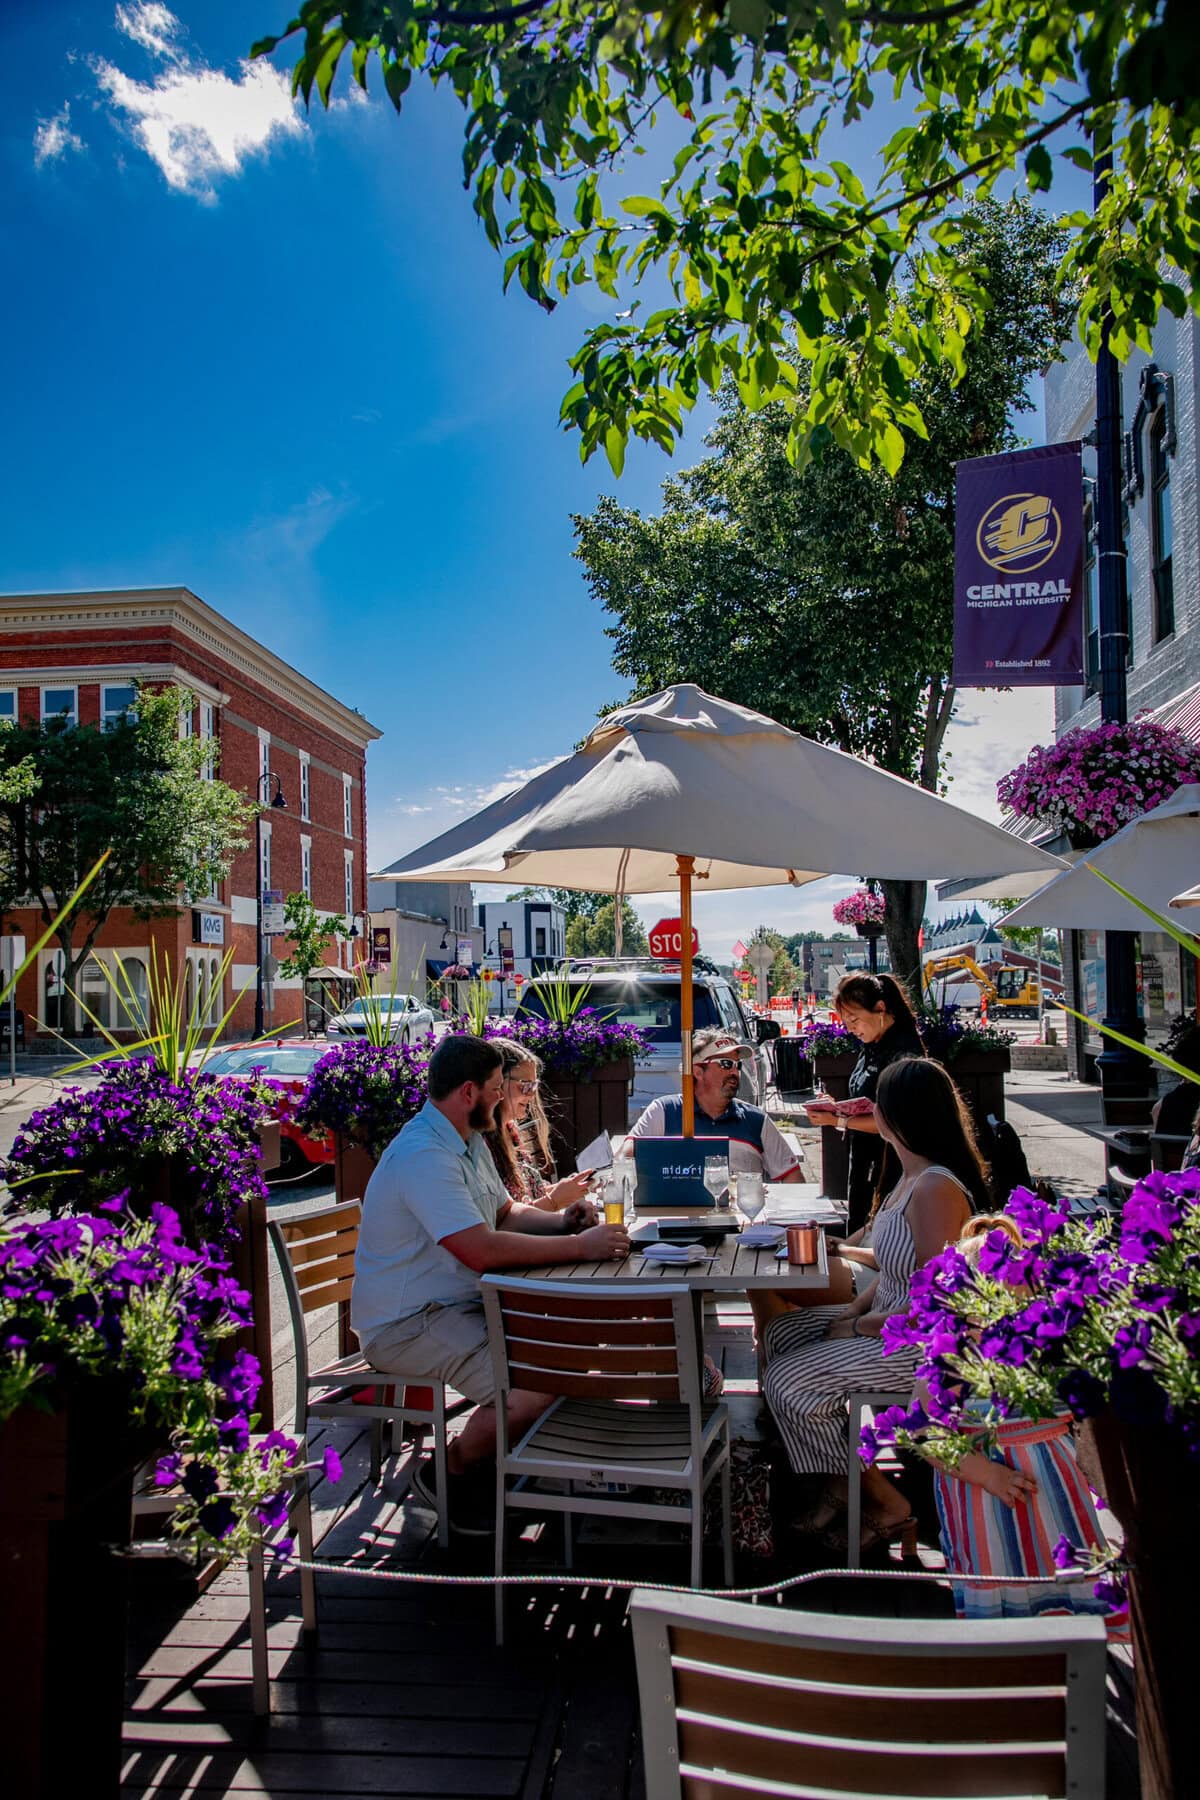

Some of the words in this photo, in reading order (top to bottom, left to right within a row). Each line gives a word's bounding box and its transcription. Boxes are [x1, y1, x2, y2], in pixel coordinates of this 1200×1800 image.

[966, 579, 1071, 600] CENTRAL
[967, 600, 1013, 608] MICHIGAN
[1016, 595, 1071, 606] UNIVERSITY
[995, 659, 1033, 668] Established
[1034, 659, 1051, 667] 1892
[662, 1163, 702, 1175] midori
